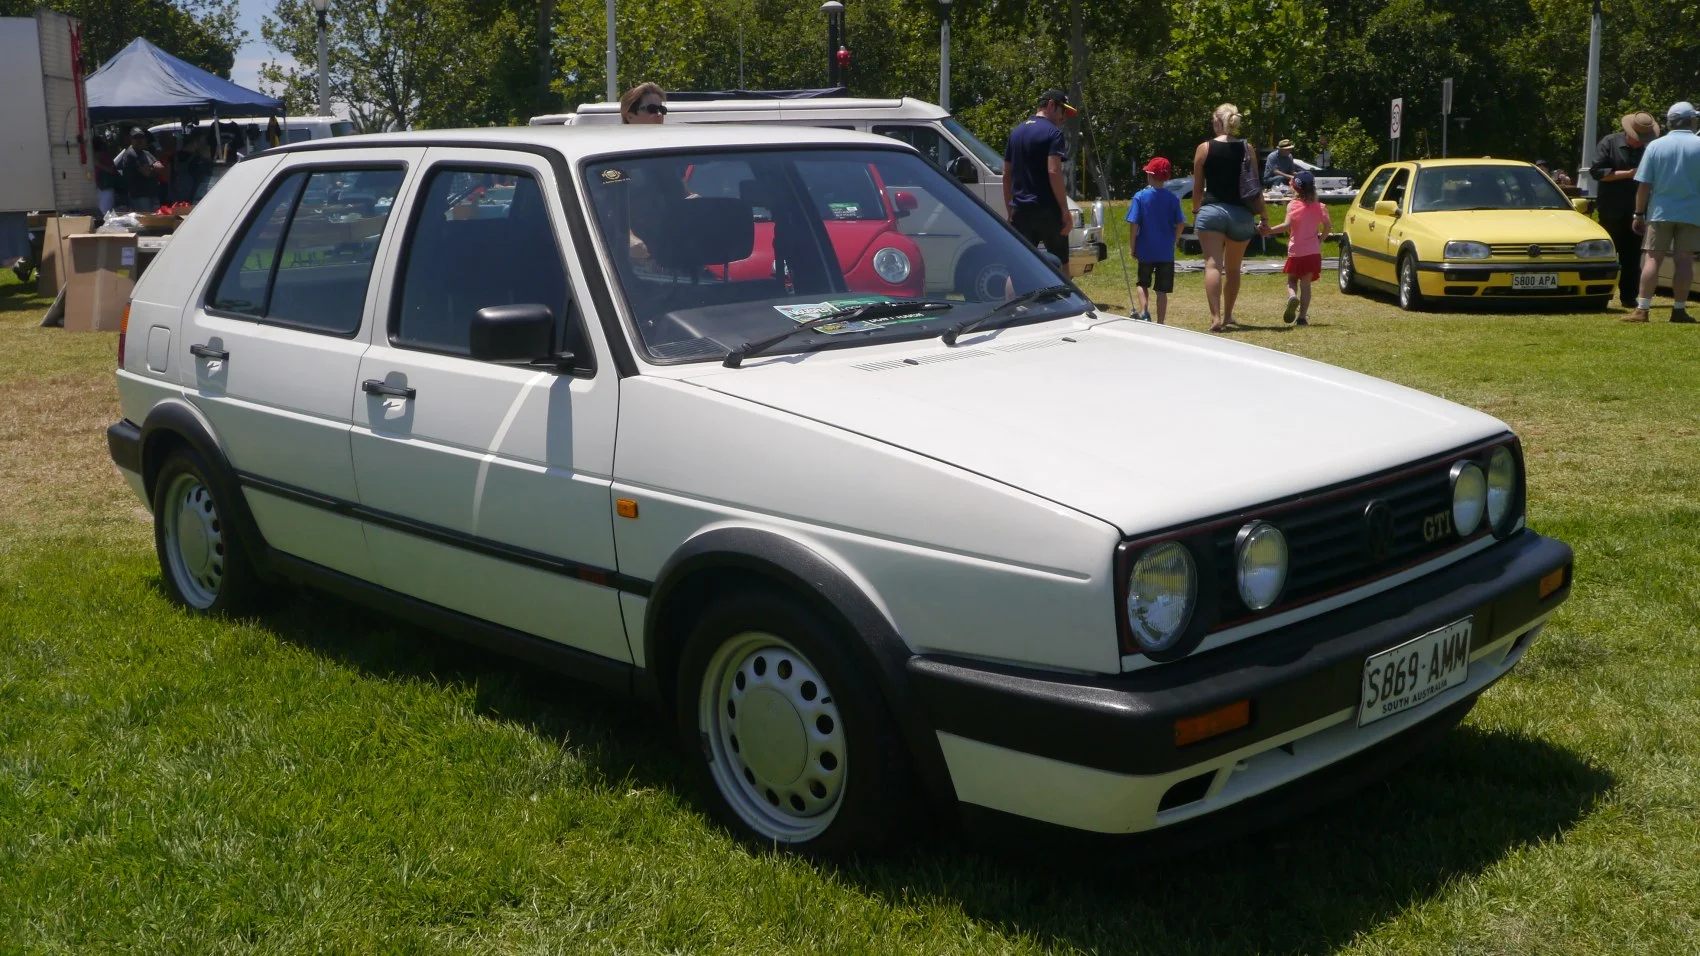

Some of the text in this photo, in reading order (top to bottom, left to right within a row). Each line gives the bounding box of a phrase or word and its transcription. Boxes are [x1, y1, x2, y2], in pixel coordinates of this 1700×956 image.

[1538, 275, 1556, 286] APA
[1423, 509, 1452, 542] GTI
[1382, 679, 1448, 714] SOUTH AUSTRALIA
